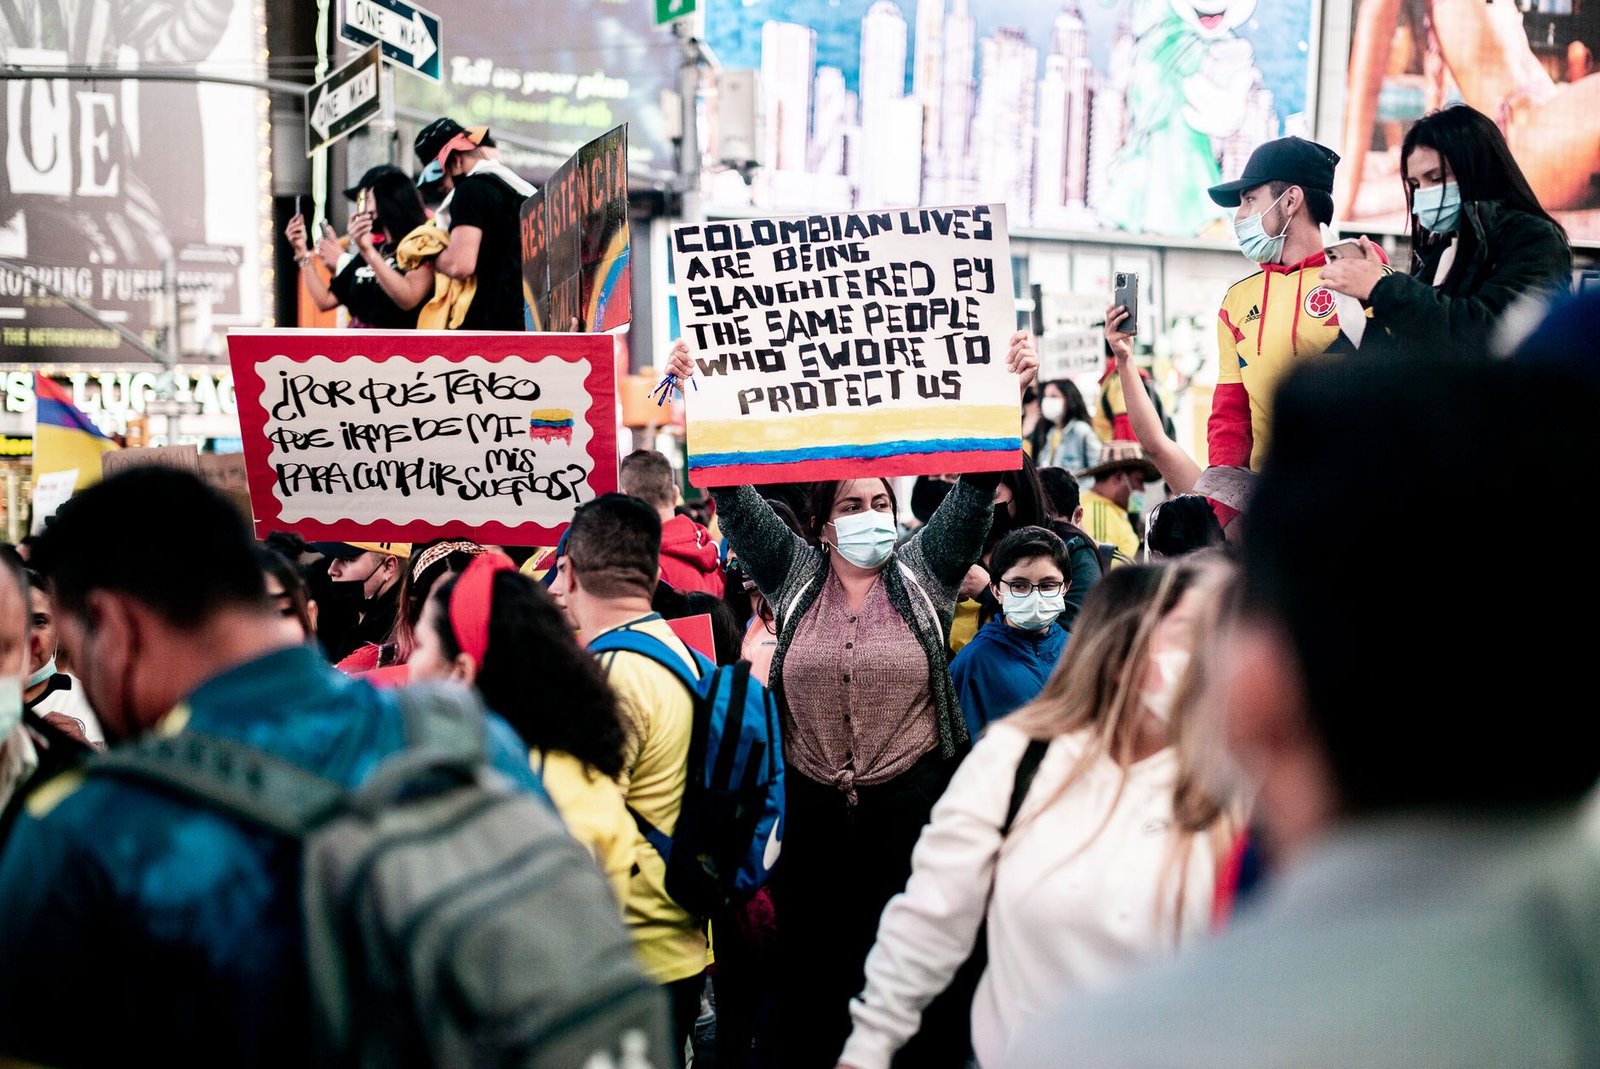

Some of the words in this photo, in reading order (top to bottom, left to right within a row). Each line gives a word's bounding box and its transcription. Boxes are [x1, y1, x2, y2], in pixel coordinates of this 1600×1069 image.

[356, 1, 386, 35] ONE
[400, 21, 428, 45] WAY
[318, 93, 339, 126] ONE
[349, 74, 371, 102] WAY
[521, 143, 627, 263] RESISTENCIA
[674, 213, 892, 253] COLOMBIAN
[900, 206, 993, 240] LIVES
[686, 251, 754, 281] ARE
[773, 242, 870, 272] BEING
[688, 261, 936, 317] SLAUGHTERED
[953, 257, 995, 294] BY
[686, 315, 752, 350] THE
[767, 304, 853, 347] SAME
[863, 296, 980, 335] PEOPLE
[695, 348, 786, 377] WHO
[798, 337, 927, 378] SWORE
[934, 332, 990, 365] TO
[272, 371, 355, 421] ¿POR
[359, 371, 436, 414] QUÉ
[434, 369, 541, 404] TENGO
[737, 369, 905, 415] PROTECT
[917, 370, 962, 400] US
[269, 427, 334, 453] QUE
[412, 417, 463, 441] DE
[467, 413, 526, 444] MI
[276, 462, 353, 497] PARA
